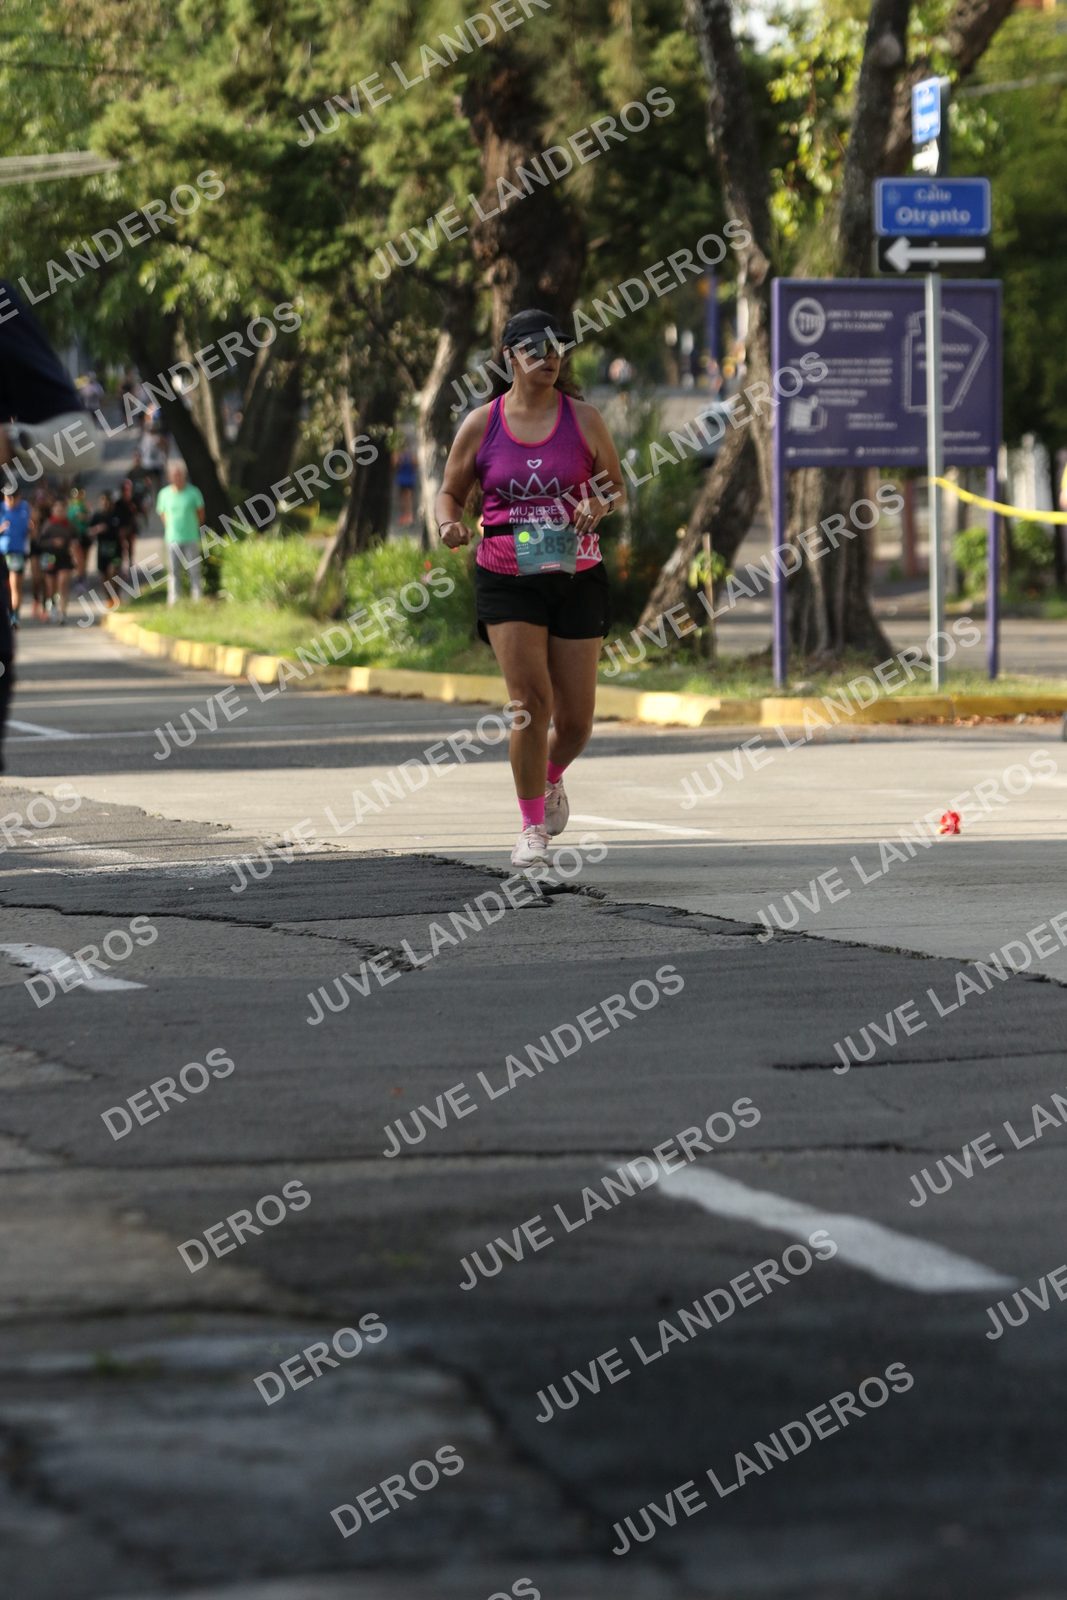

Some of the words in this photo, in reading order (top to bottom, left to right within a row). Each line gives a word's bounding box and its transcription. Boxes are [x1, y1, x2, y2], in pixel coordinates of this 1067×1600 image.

[914, 187, 952, 203] Calle
[895, 206, 971, 226] Otranto
[509, 505, 564, 517] MUJERES
[534, 535, 575, 556] 1852
